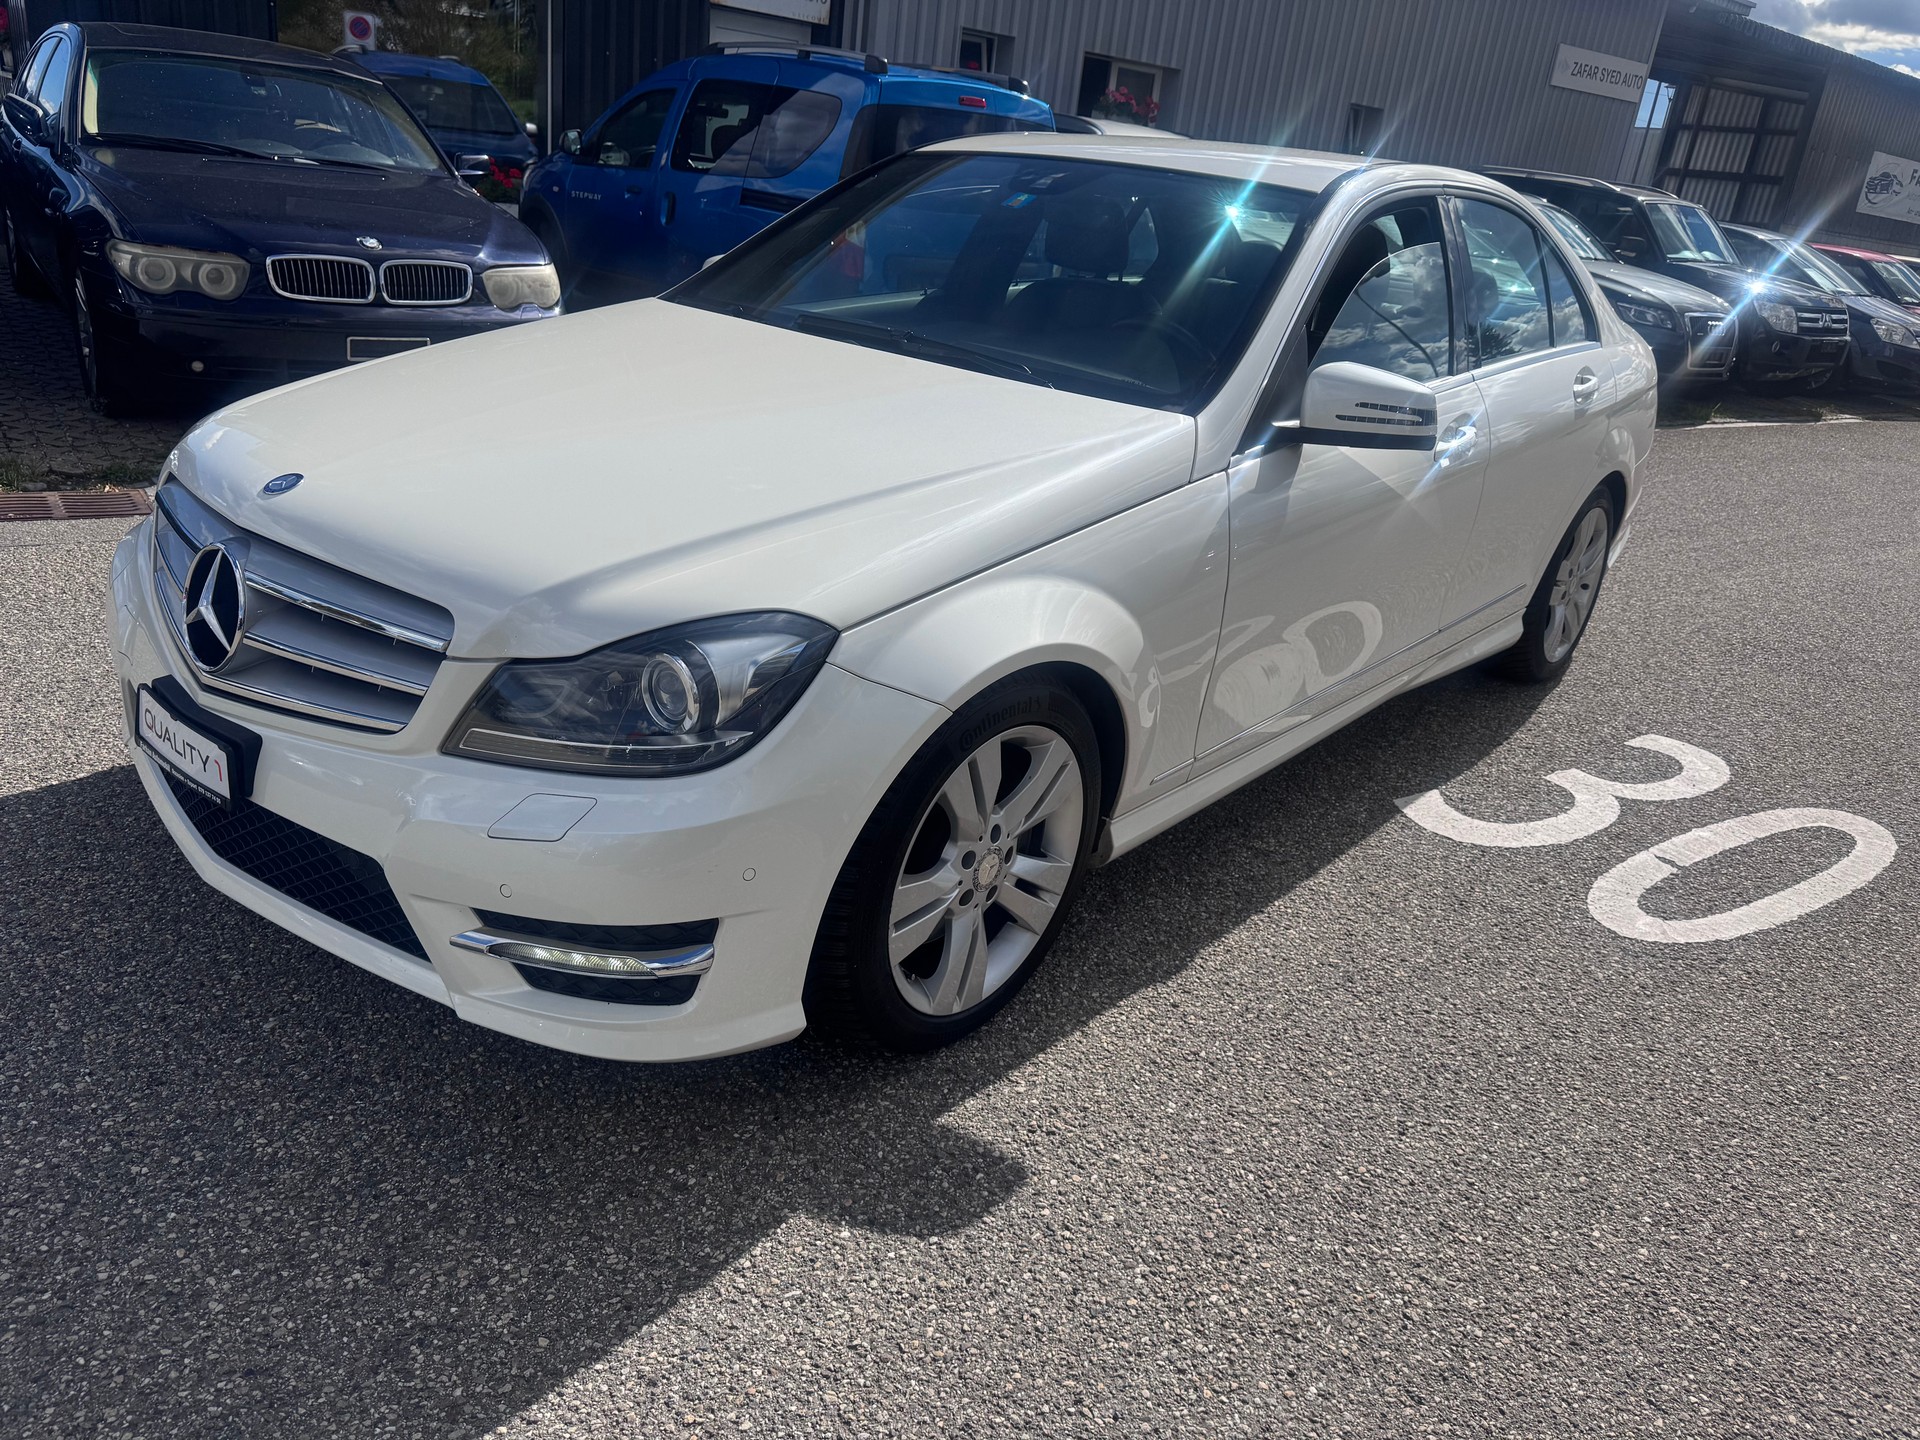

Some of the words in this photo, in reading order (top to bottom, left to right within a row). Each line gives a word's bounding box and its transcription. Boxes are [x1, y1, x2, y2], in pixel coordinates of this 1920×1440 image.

[1570, 61, 1600, 81] ZAFAR
[1600, 67, 1622, 86] SYED
[1621, 72, 1644, 90] AUTO
[571, 190, 602, 201] STEPWAY
[960, 696, 1033, 752] Continental
[1393, 733, 1898, 943] 30
